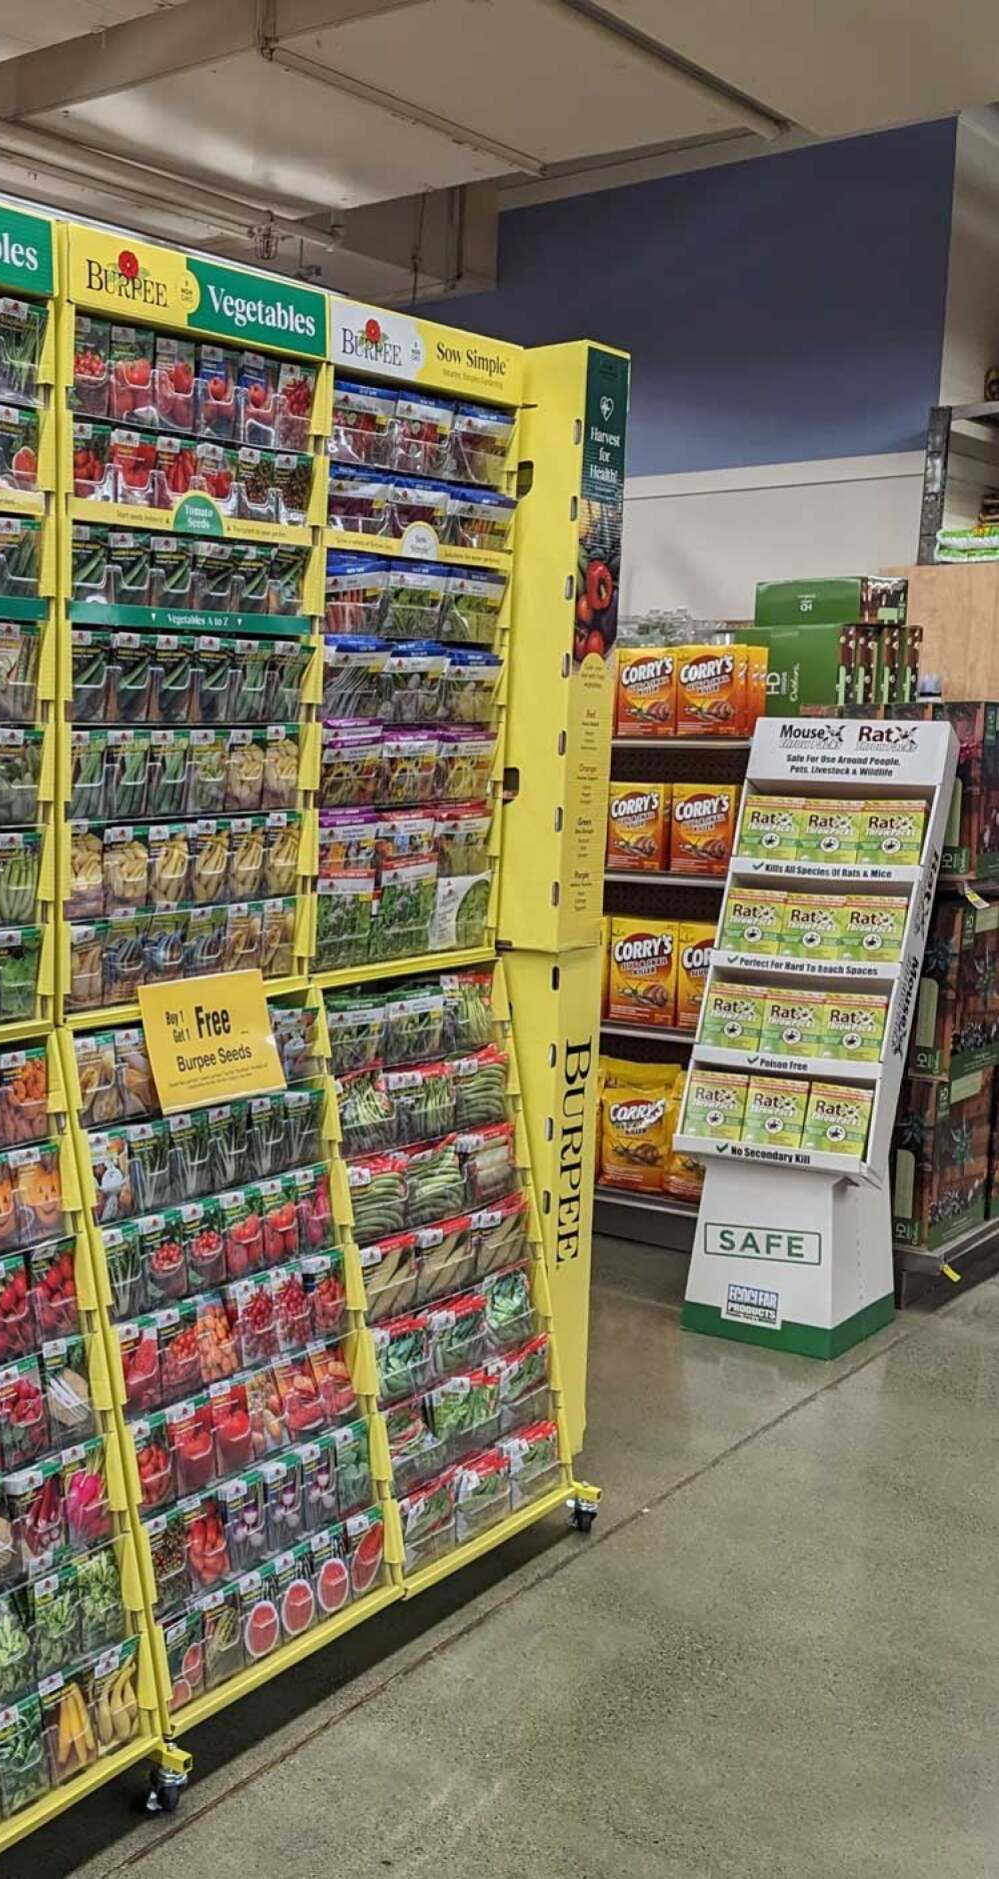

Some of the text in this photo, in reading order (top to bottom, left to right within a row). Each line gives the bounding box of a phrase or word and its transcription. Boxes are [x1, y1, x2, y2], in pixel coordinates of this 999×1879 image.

[85, 258, 169, 308] BURPEE
[207, 284, 316, 338] Vegetables
[341, 327, 403, 367] BURPEE
[436, 341, 463, 362] Sow
[466, 348, 507, 377] Simple
[590, 426, 621, 447] Harvest
[598, 447, 611, 463] for
[589, 463, 620, 484] Health!
[185, 504, 214, 519] Tomato
[187, 516, 211, 531] Seeds
[167, 612, 230, 628] Vegetables A to Z
[621, 655, 674, 687] CORRY'S
[679, 654, 734, 686] CORRY'S
[786, 754, 805, 763] Safe
[806, 754, 820, 764] For
[820, 755, 836, 764] Use
[837, 756, 868, 766] Around
[811, 766, 850, 776] Livestock
[851, 768, 858, 776] &
[858, 767, 894, 777] Wildlife
[611, 791, 660, 819] CORRY'S
[674, 793, 730, 822] CORRY'S
[764, 863, 893, 879] Kills All Species Of Rats & Mice
[614, 934, 674, 963] CORRY'S
[739, 957, 878, 977] Perfect For Hard To Reach Spaces
[165, 1009, 185, 1028] Buy 1
[194, 1005, 232, 1040] Free
[172, 1028, 192, 1044] Get 1
[176, 1043, 253, 1074] Burpee Seeds
[759, 1057, 808, 1072] Poison Free
[556, 1038, 592, 1263] BURPEE
[730, 1145, 811, 1165] No Secondary Kill
[719, 1229, 806, 1260] SAFE
[726, 1303, 777, 1321] PRODUCTS
